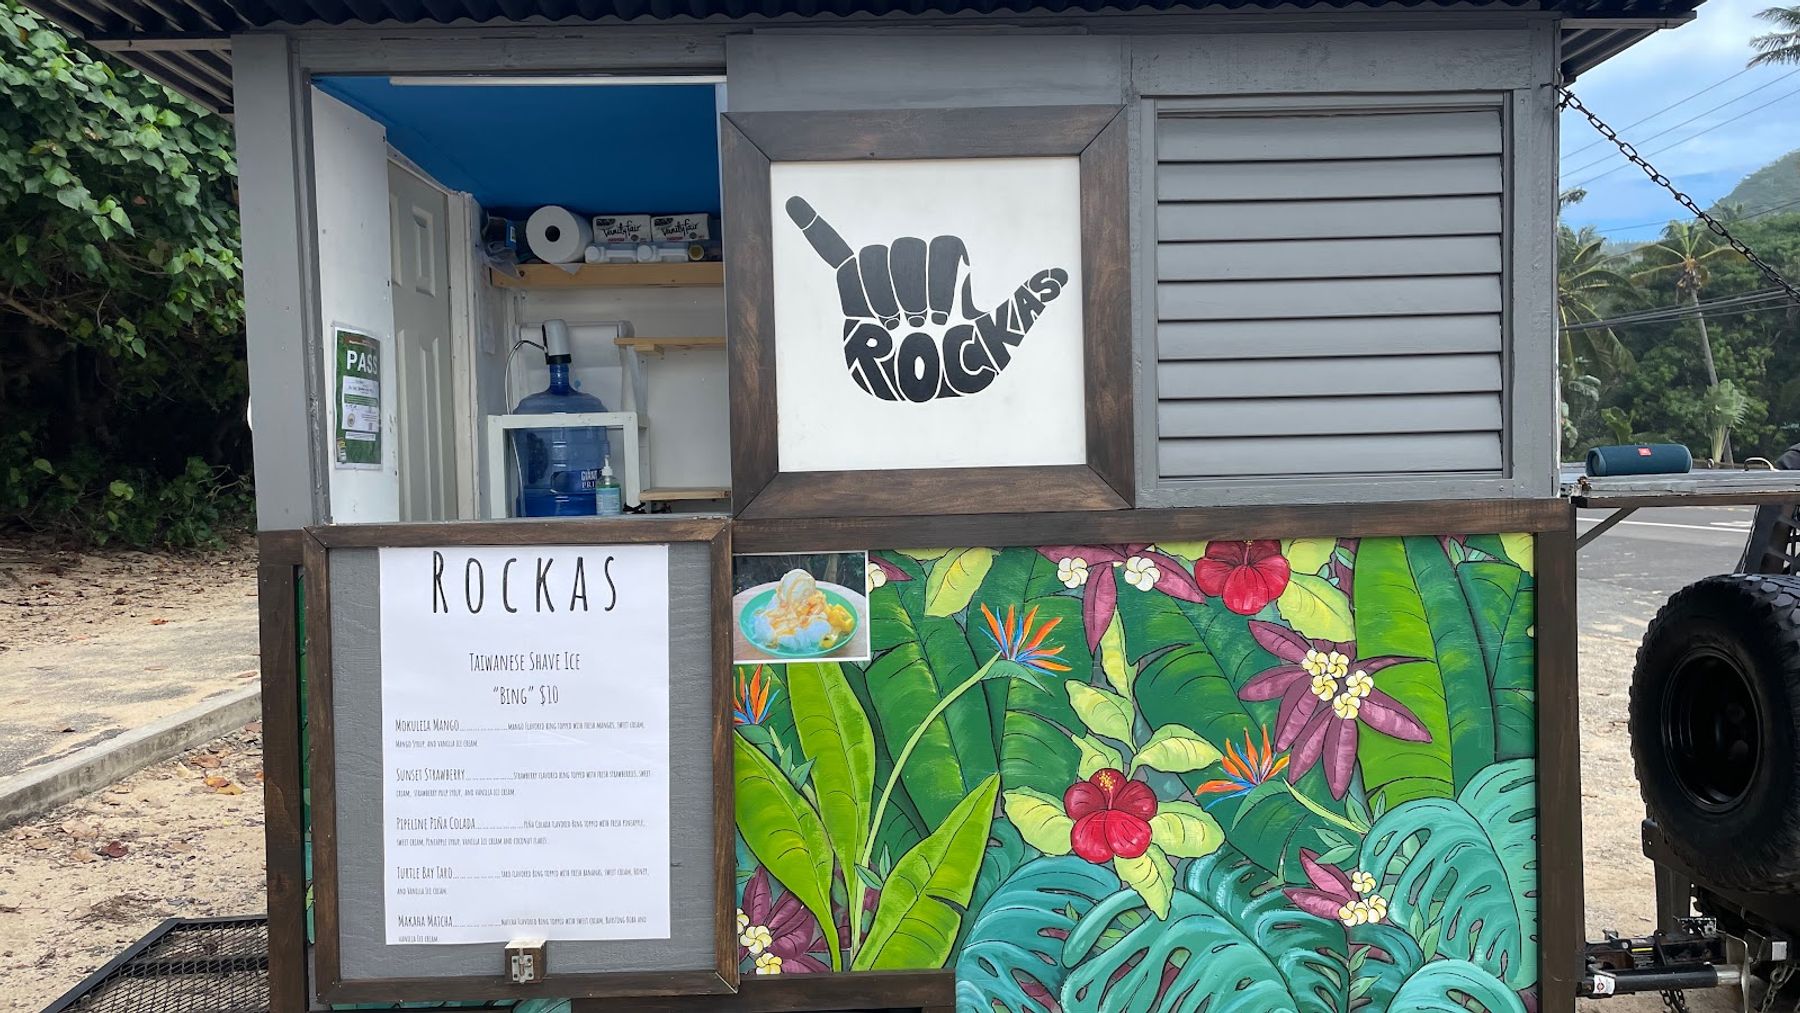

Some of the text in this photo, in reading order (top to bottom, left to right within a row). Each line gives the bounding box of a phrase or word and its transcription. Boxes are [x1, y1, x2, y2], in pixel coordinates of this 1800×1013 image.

[844, 267, 1068, 403] ROCKAS
[346, 350, 378, 375] PASS
[581, 481, 597, 489] PRI
[432, 550, 617, 614] ROCKAS
[539, 685, 560, 705] $10
